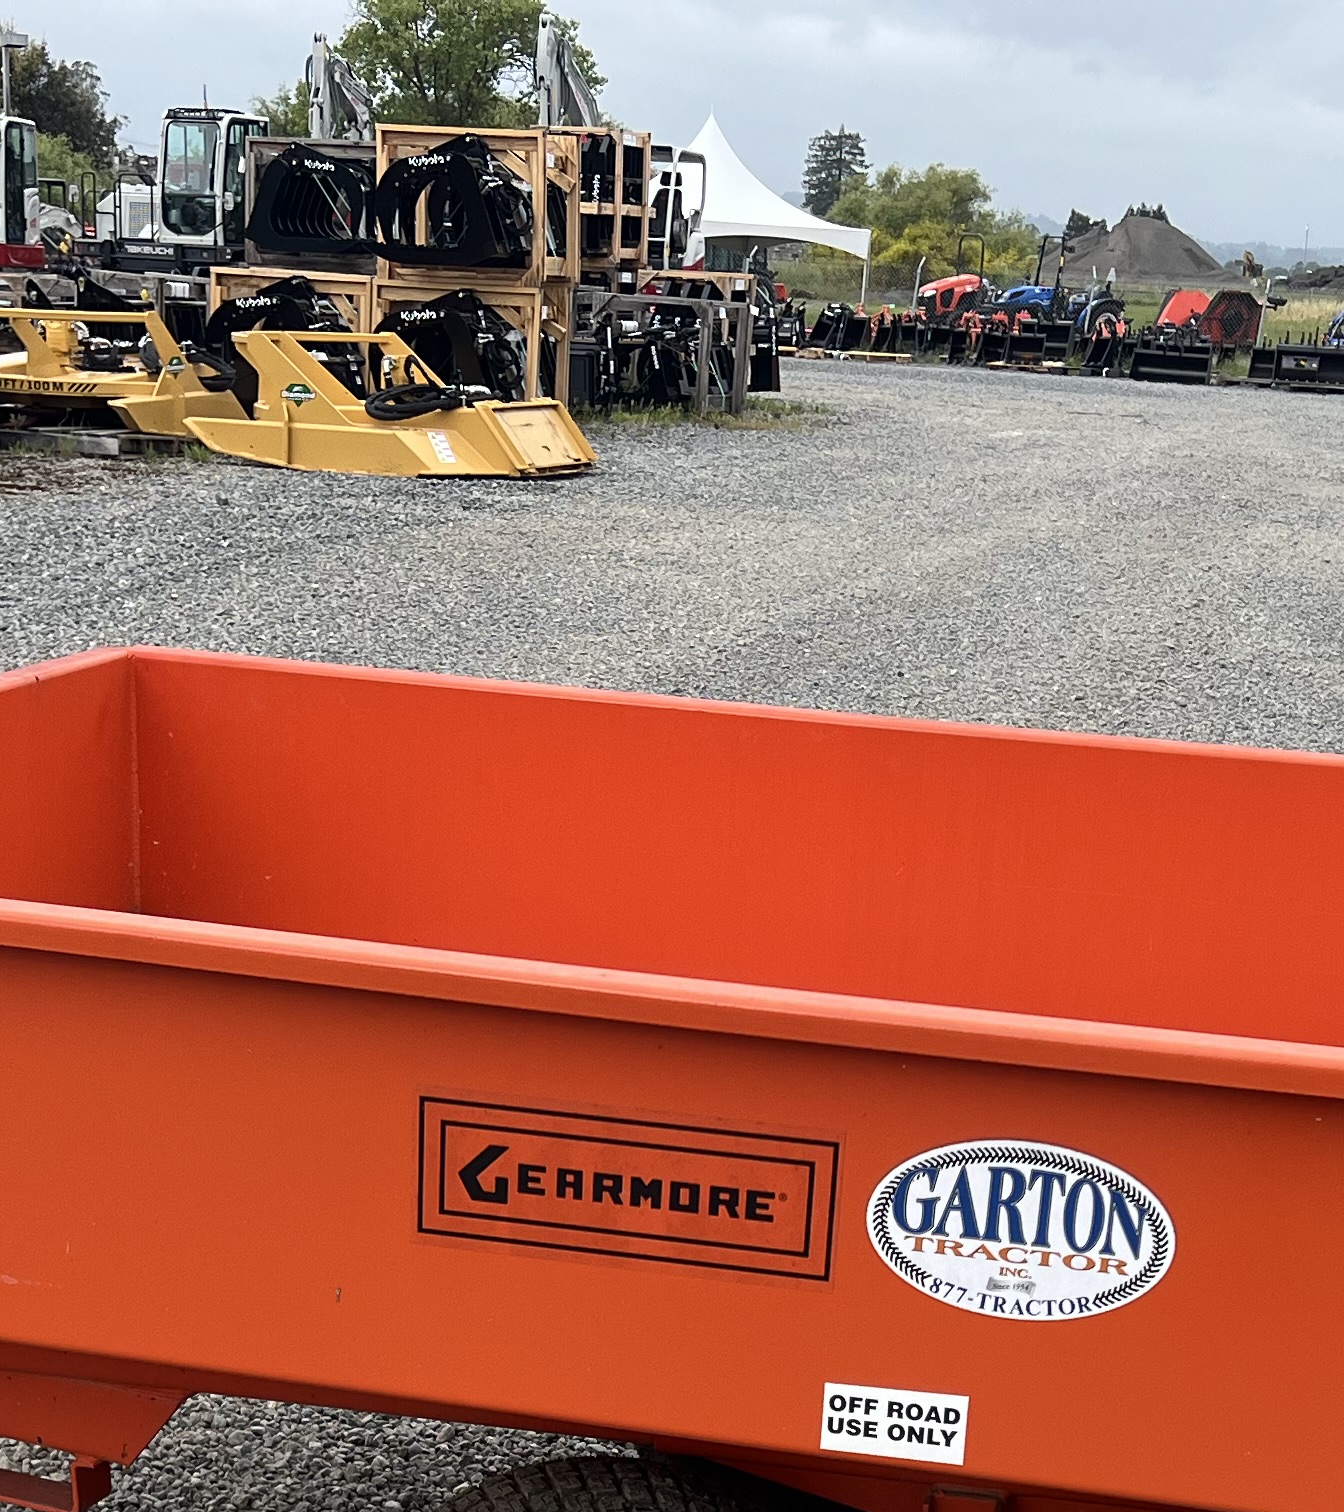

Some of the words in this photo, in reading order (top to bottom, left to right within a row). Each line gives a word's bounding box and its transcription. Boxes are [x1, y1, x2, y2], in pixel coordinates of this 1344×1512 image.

[304, 159, 335, 172] Kubota
[408, 153, 444, 167] Kubota
[124, 245, 174, 255] TAKEUCHI
[236, 296, 271, 308] Kubota
[401, 309, 436, 321] Kubota
[458, 1143, 776, 1224] GEARMORE
[891, 1165, 1149, 1261] GARTON
[904, 1235, 1129, 1277] TRACTOR
[999, 1266, 1033, 1280] INC.
[929, 1276, 1094, 1317] 877-TRACTOR
[829, 1394, 879, 1415] OFF
[887, 1400, 961, 1425] ROAD
[827, 1416, 878, 1439] USE
[887, 1423, 958, 1448] ONLY
